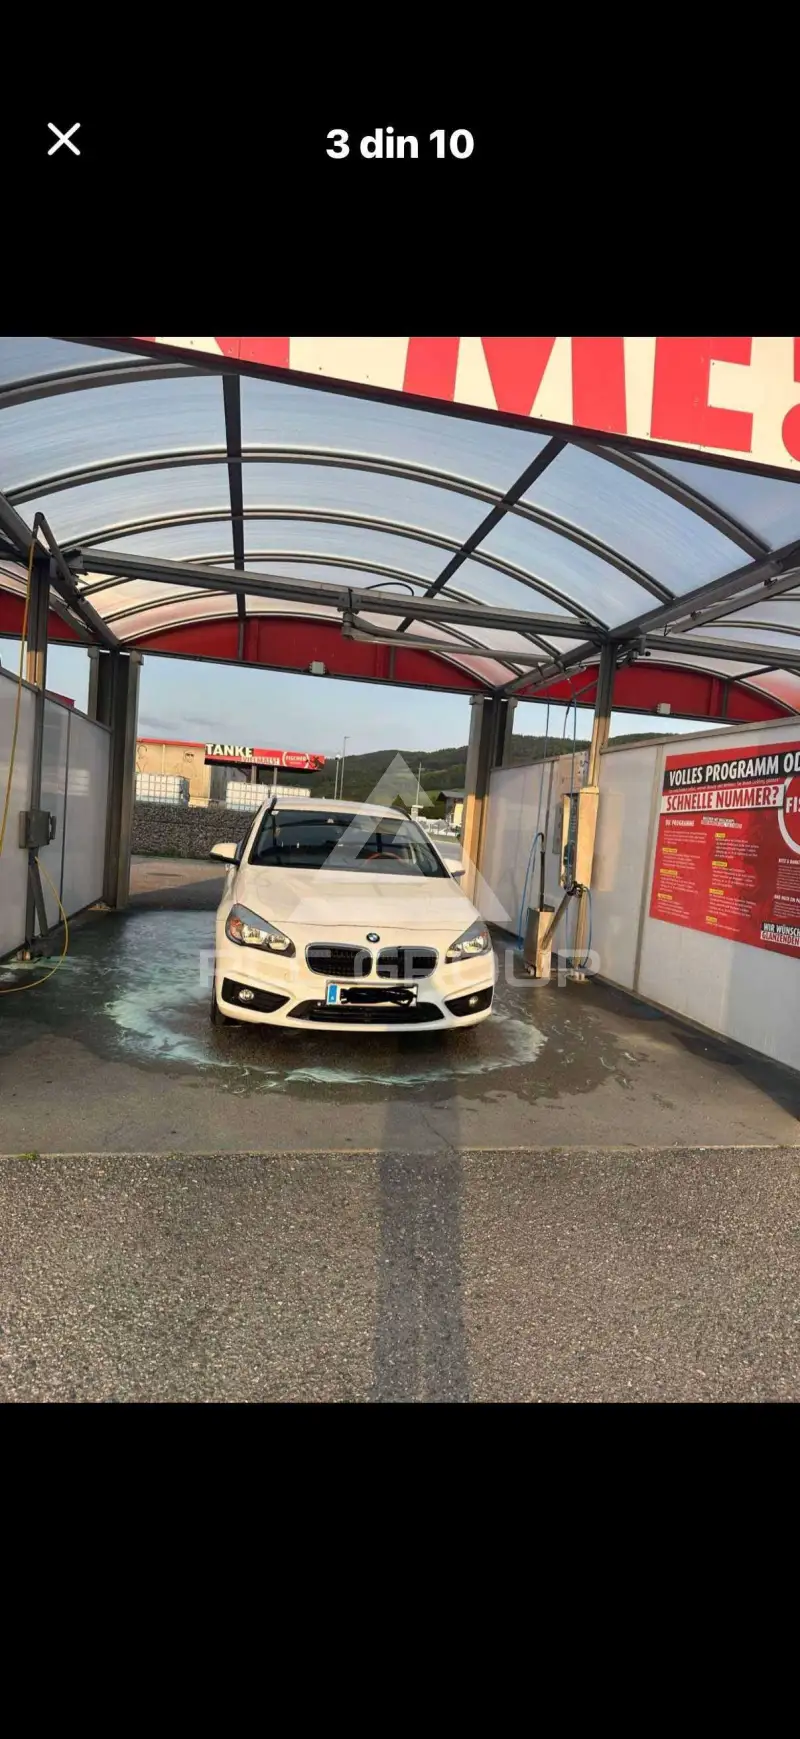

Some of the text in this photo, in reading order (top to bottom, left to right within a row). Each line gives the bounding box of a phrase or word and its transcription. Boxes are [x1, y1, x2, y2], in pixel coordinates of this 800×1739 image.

[205, 744, 253, 757] TANKE
[669, 766, 703, 787] VOLLES
[705, 755, 779, 782] PROGRAMM
[666, 786, 780, 811] SCHNELLE NUMMER?
[763, 923, 775, 932] WIR
